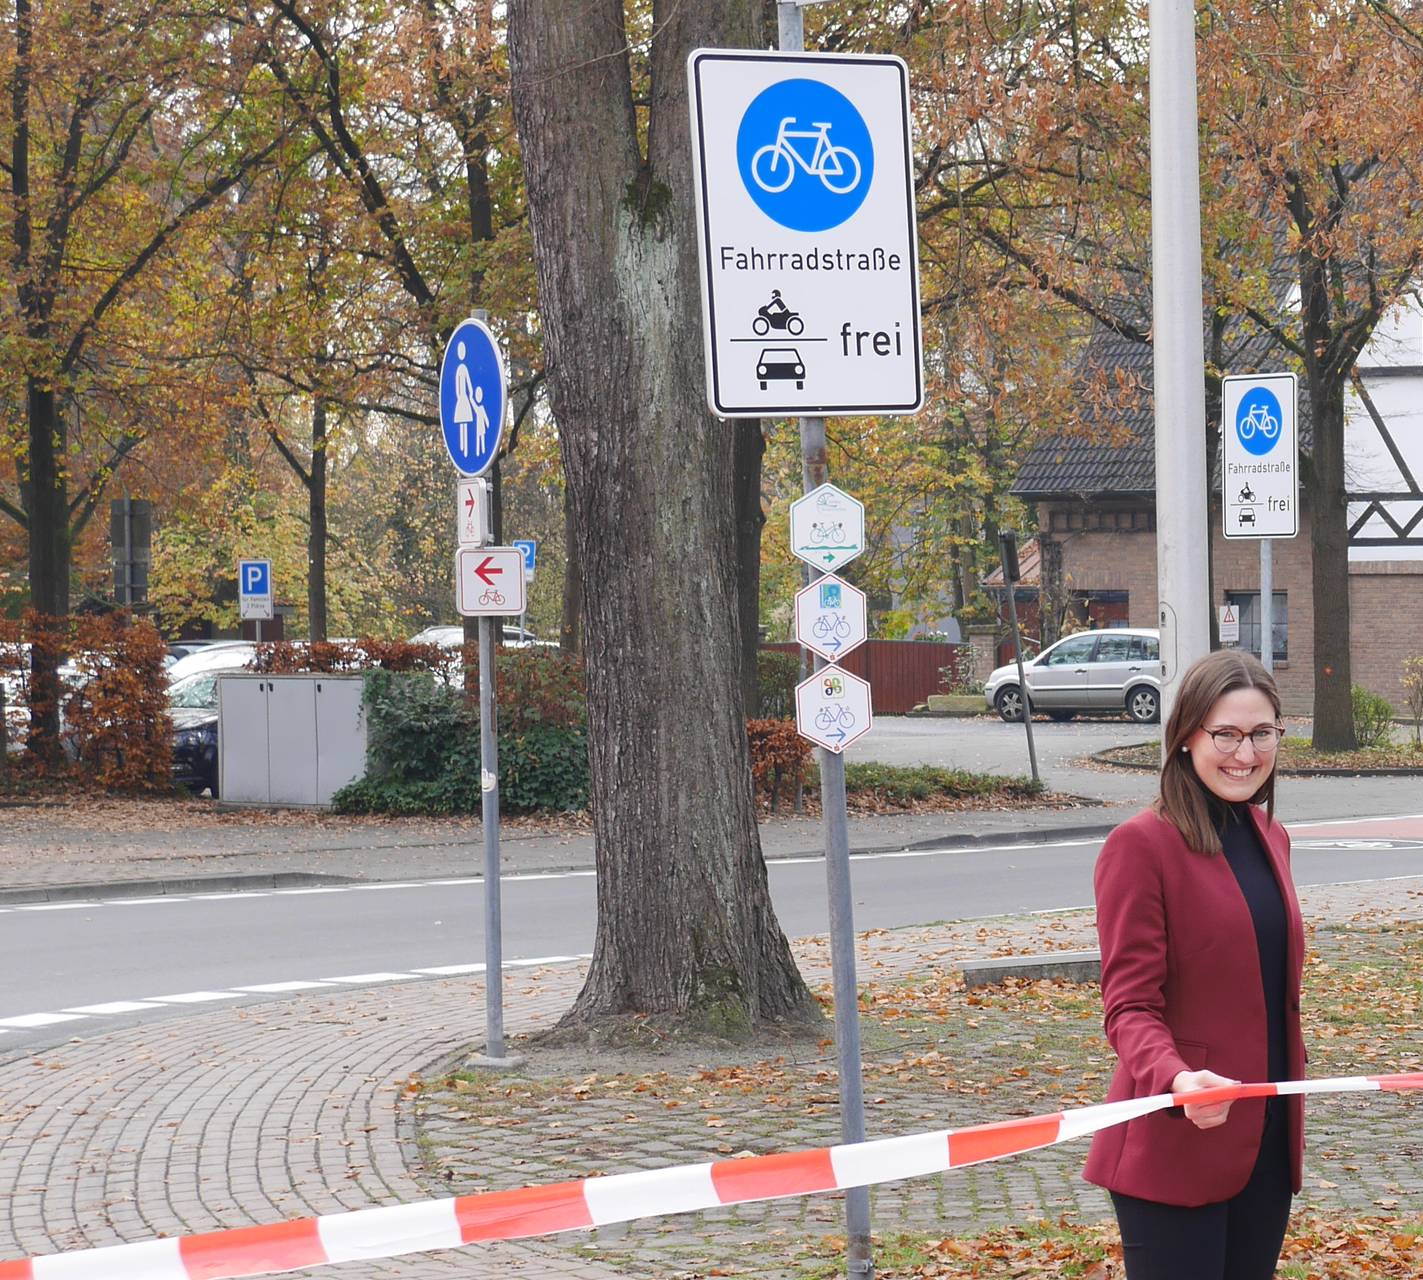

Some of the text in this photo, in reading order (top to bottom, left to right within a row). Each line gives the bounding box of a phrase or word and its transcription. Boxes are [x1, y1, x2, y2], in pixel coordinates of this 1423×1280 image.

[720, 246, 901, 271] Fahrradstraße
[840, 321, 902, 357] frei
[1228, 461, 1290, 474] Fahrradstraße
[1268, 495, 1290, 511] frei
[247, 566, 262, 591] P
